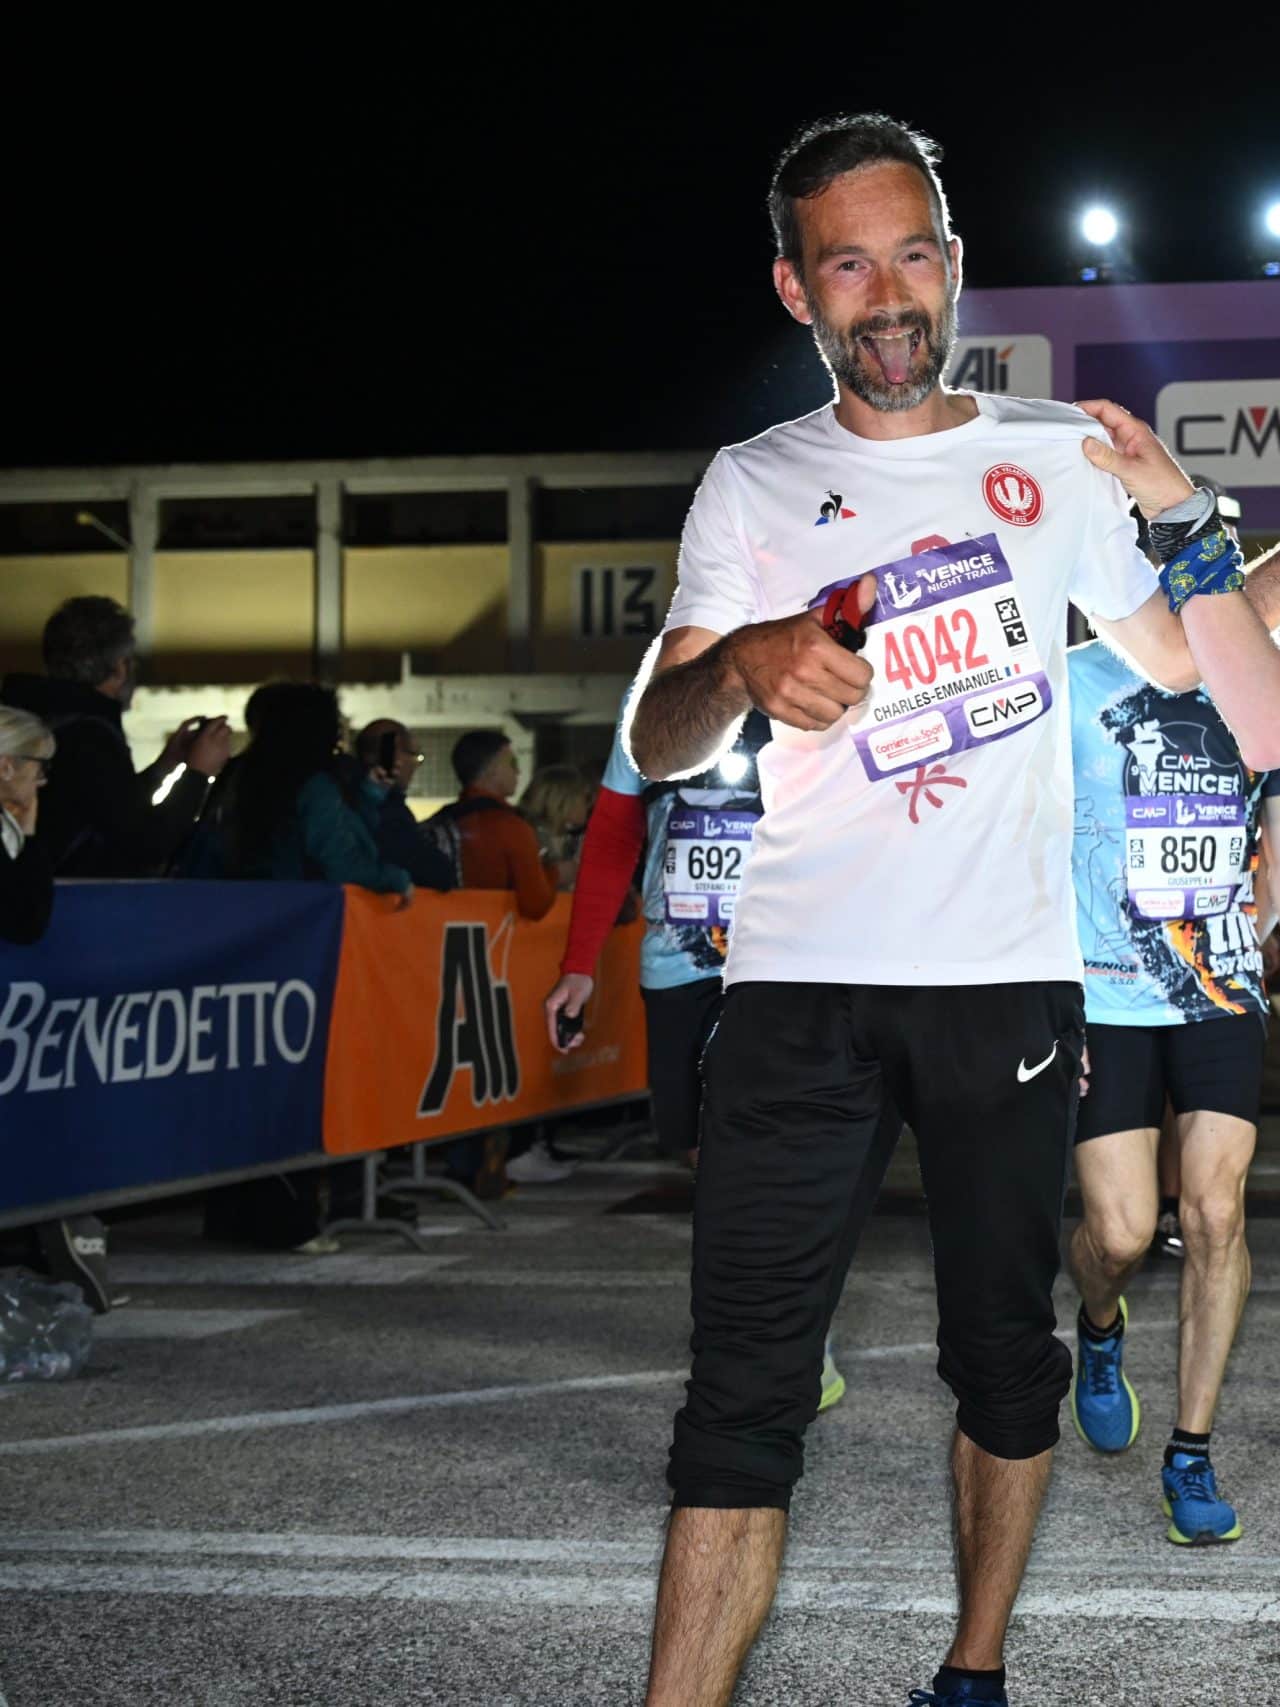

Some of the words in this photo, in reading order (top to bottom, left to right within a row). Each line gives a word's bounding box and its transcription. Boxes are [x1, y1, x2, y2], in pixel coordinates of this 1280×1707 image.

[920, 553, 995, 583] VENICE
[927, 575, 962, 593] NIGHT
[964, 566, 998, 581] TRAIL
[580, 568, 656, 635] 113
[884, 608, 989, 691] 4042
[873, 668, 1003, 722] CHARLES-EMMANUEL
[970, 691, 1037, 728] CMP
[1162, 754, 1211, 770] CMP
[1139, 771, 1233, 795] VENICE
[1132, 806, 1167, 819] CMP
[688, 845, 742, 880] 692
[1160, 835, 1217, 874] 850
[1196, 894, 1228, 909] CMP
[1083, 959, 1138, 973] VENICE
[0, 979, 316, 1097] BENEDETTO
